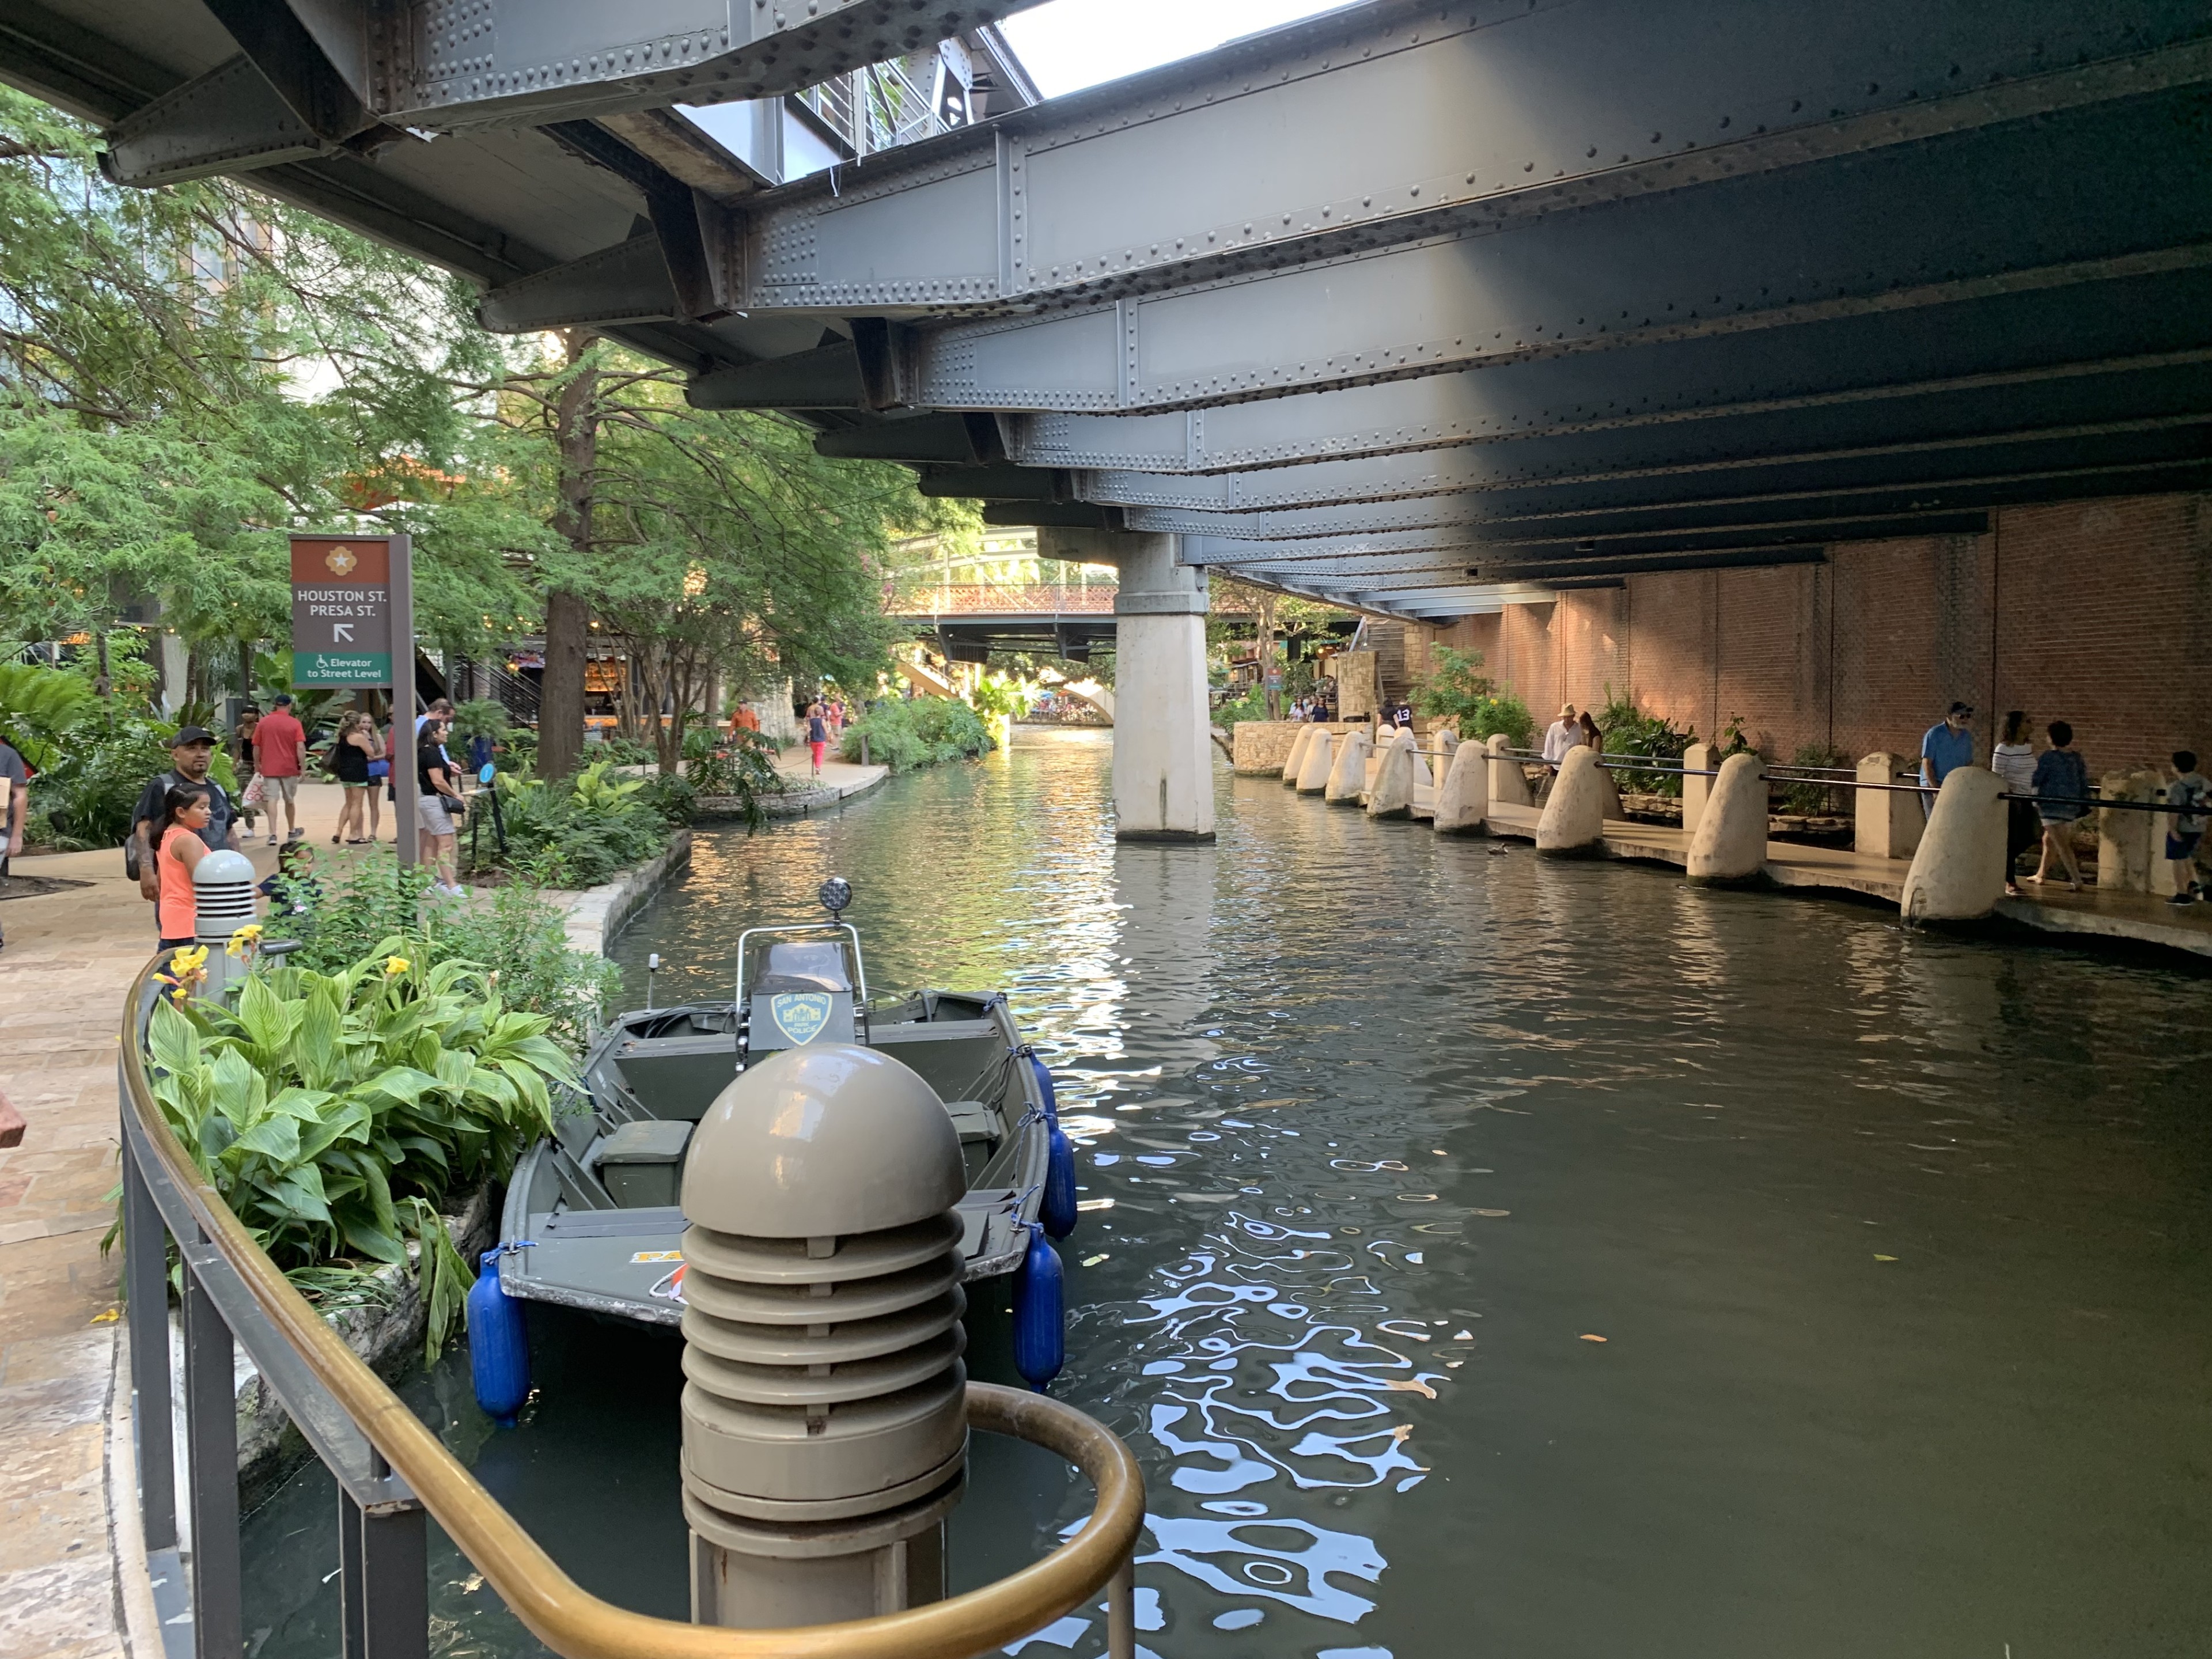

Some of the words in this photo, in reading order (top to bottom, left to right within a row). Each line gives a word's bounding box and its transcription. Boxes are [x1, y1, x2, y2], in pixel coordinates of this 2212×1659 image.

[298, 590, 364, 601] HOUSTON
[368, 591, 387, 602] ST.
[310, 605, 353, 616] PRESA
[357, 605, 376, 616] ST.
[331, 658, 372, 666] Elevator
[321, 669, 352, 677] Street
[355, 669, 381, 677] Level
[1397, 709, 1410, 722] 13
[777, 995, 792, 1007] SAN
[794, 994, 826, 1005] ANTONIO
[787, 1024, 817, 1033] POLICE
